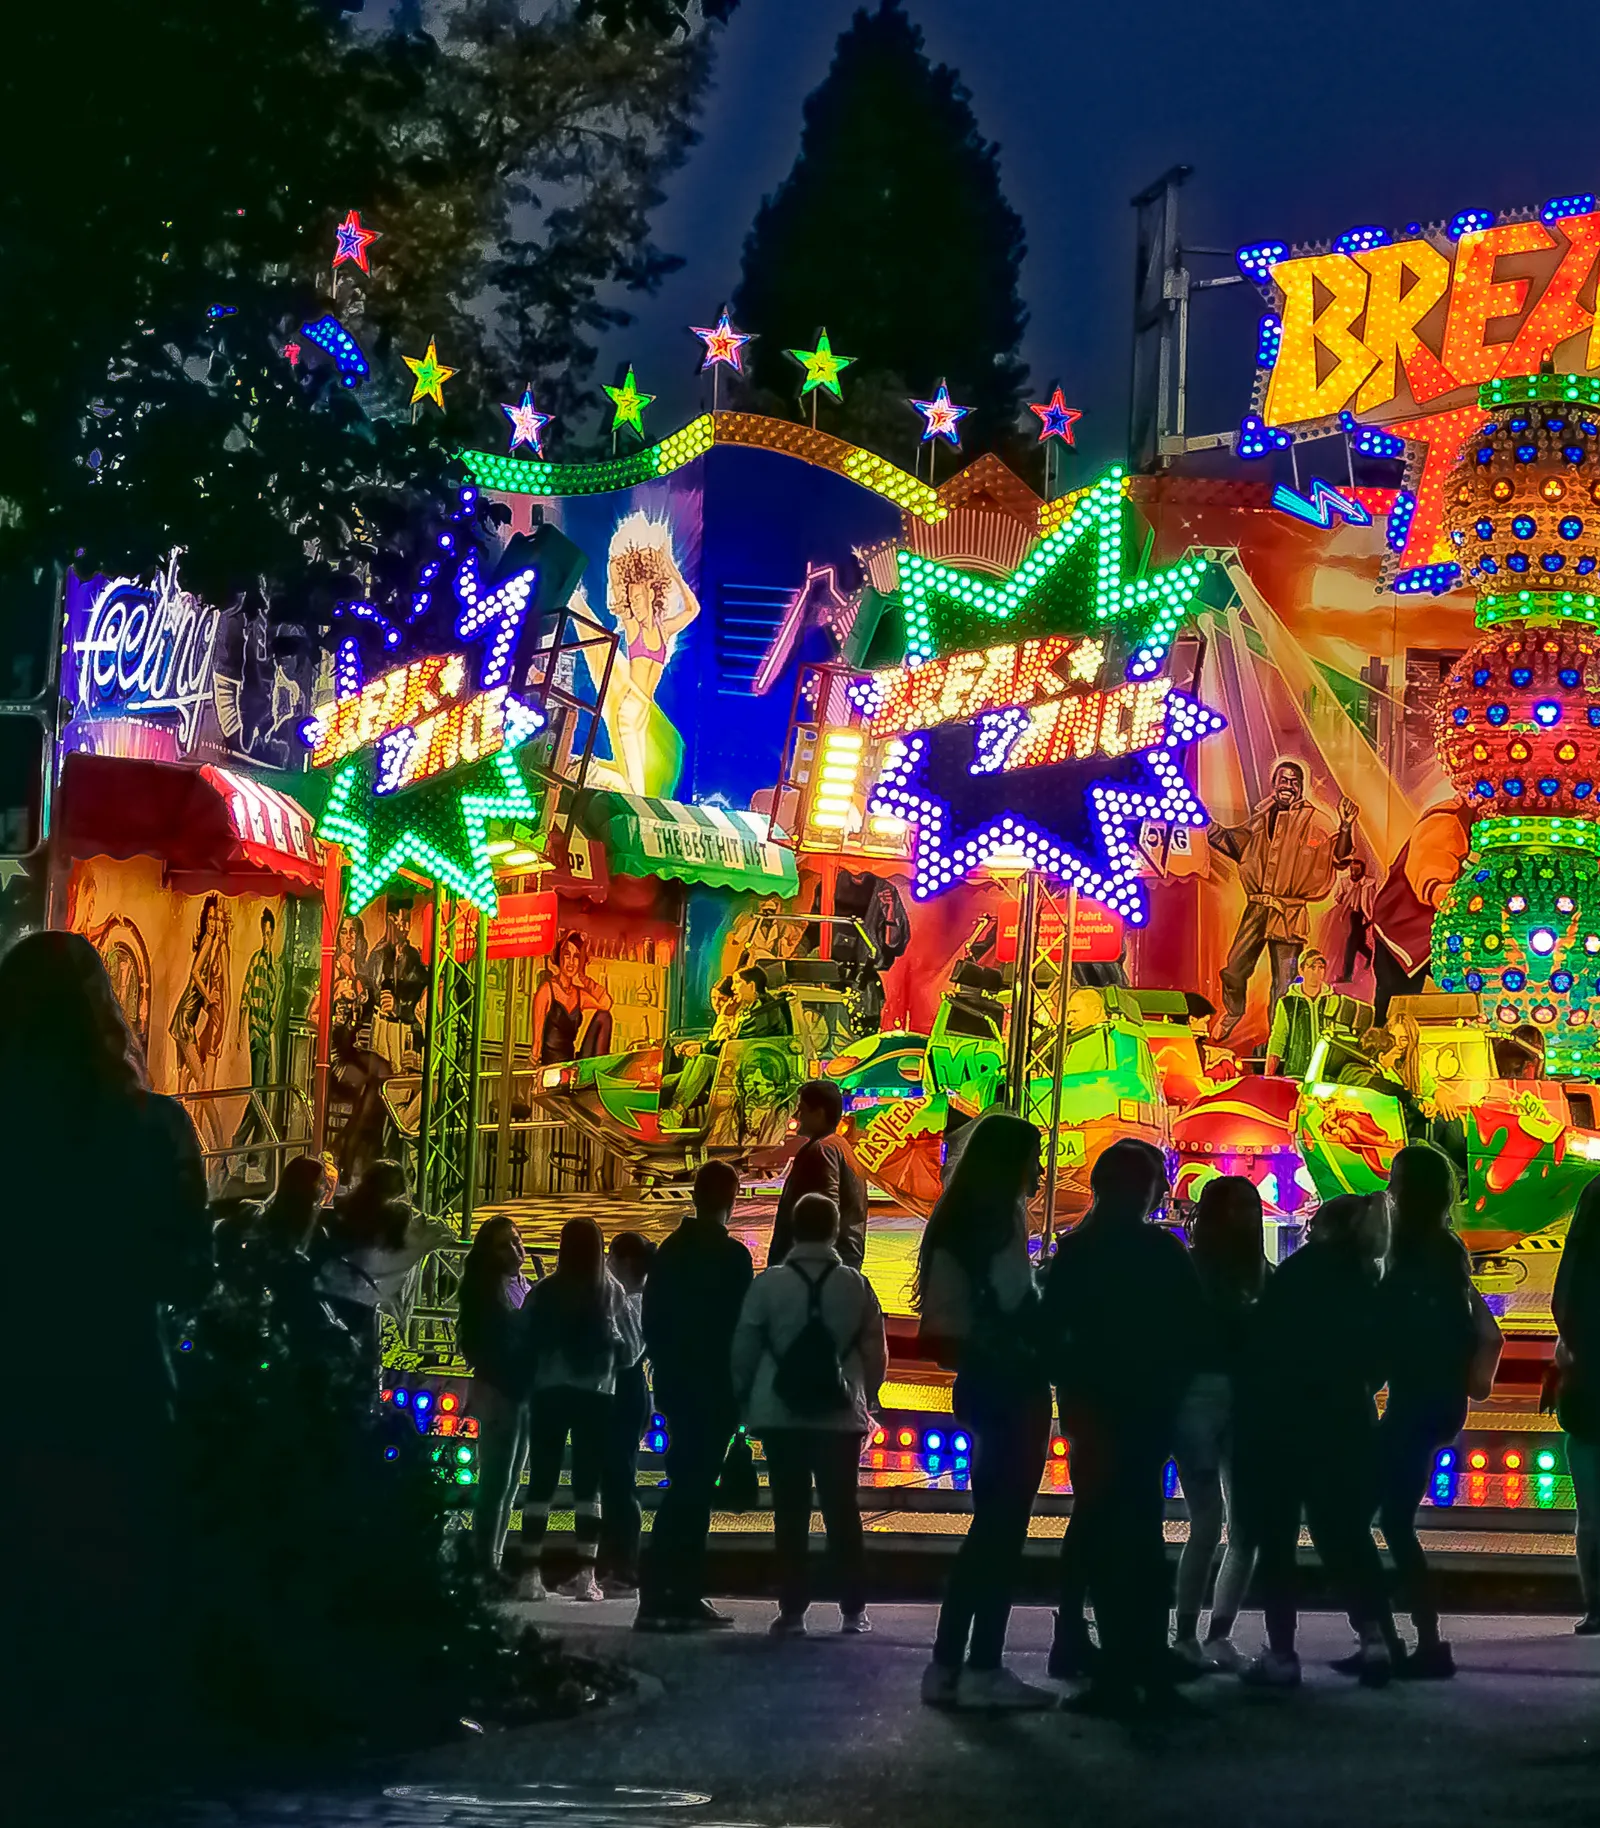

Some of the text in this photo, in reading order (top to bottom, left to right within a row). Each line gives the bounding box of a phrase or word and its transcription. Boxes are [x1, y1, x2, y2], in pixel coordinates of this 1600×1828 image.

[653, 826, 768, 868] THE BEST HIT LIST
[1077, 911, 1102, 921] Fahrt
[857, 1096, 928, 1168] LAS VEGAS
